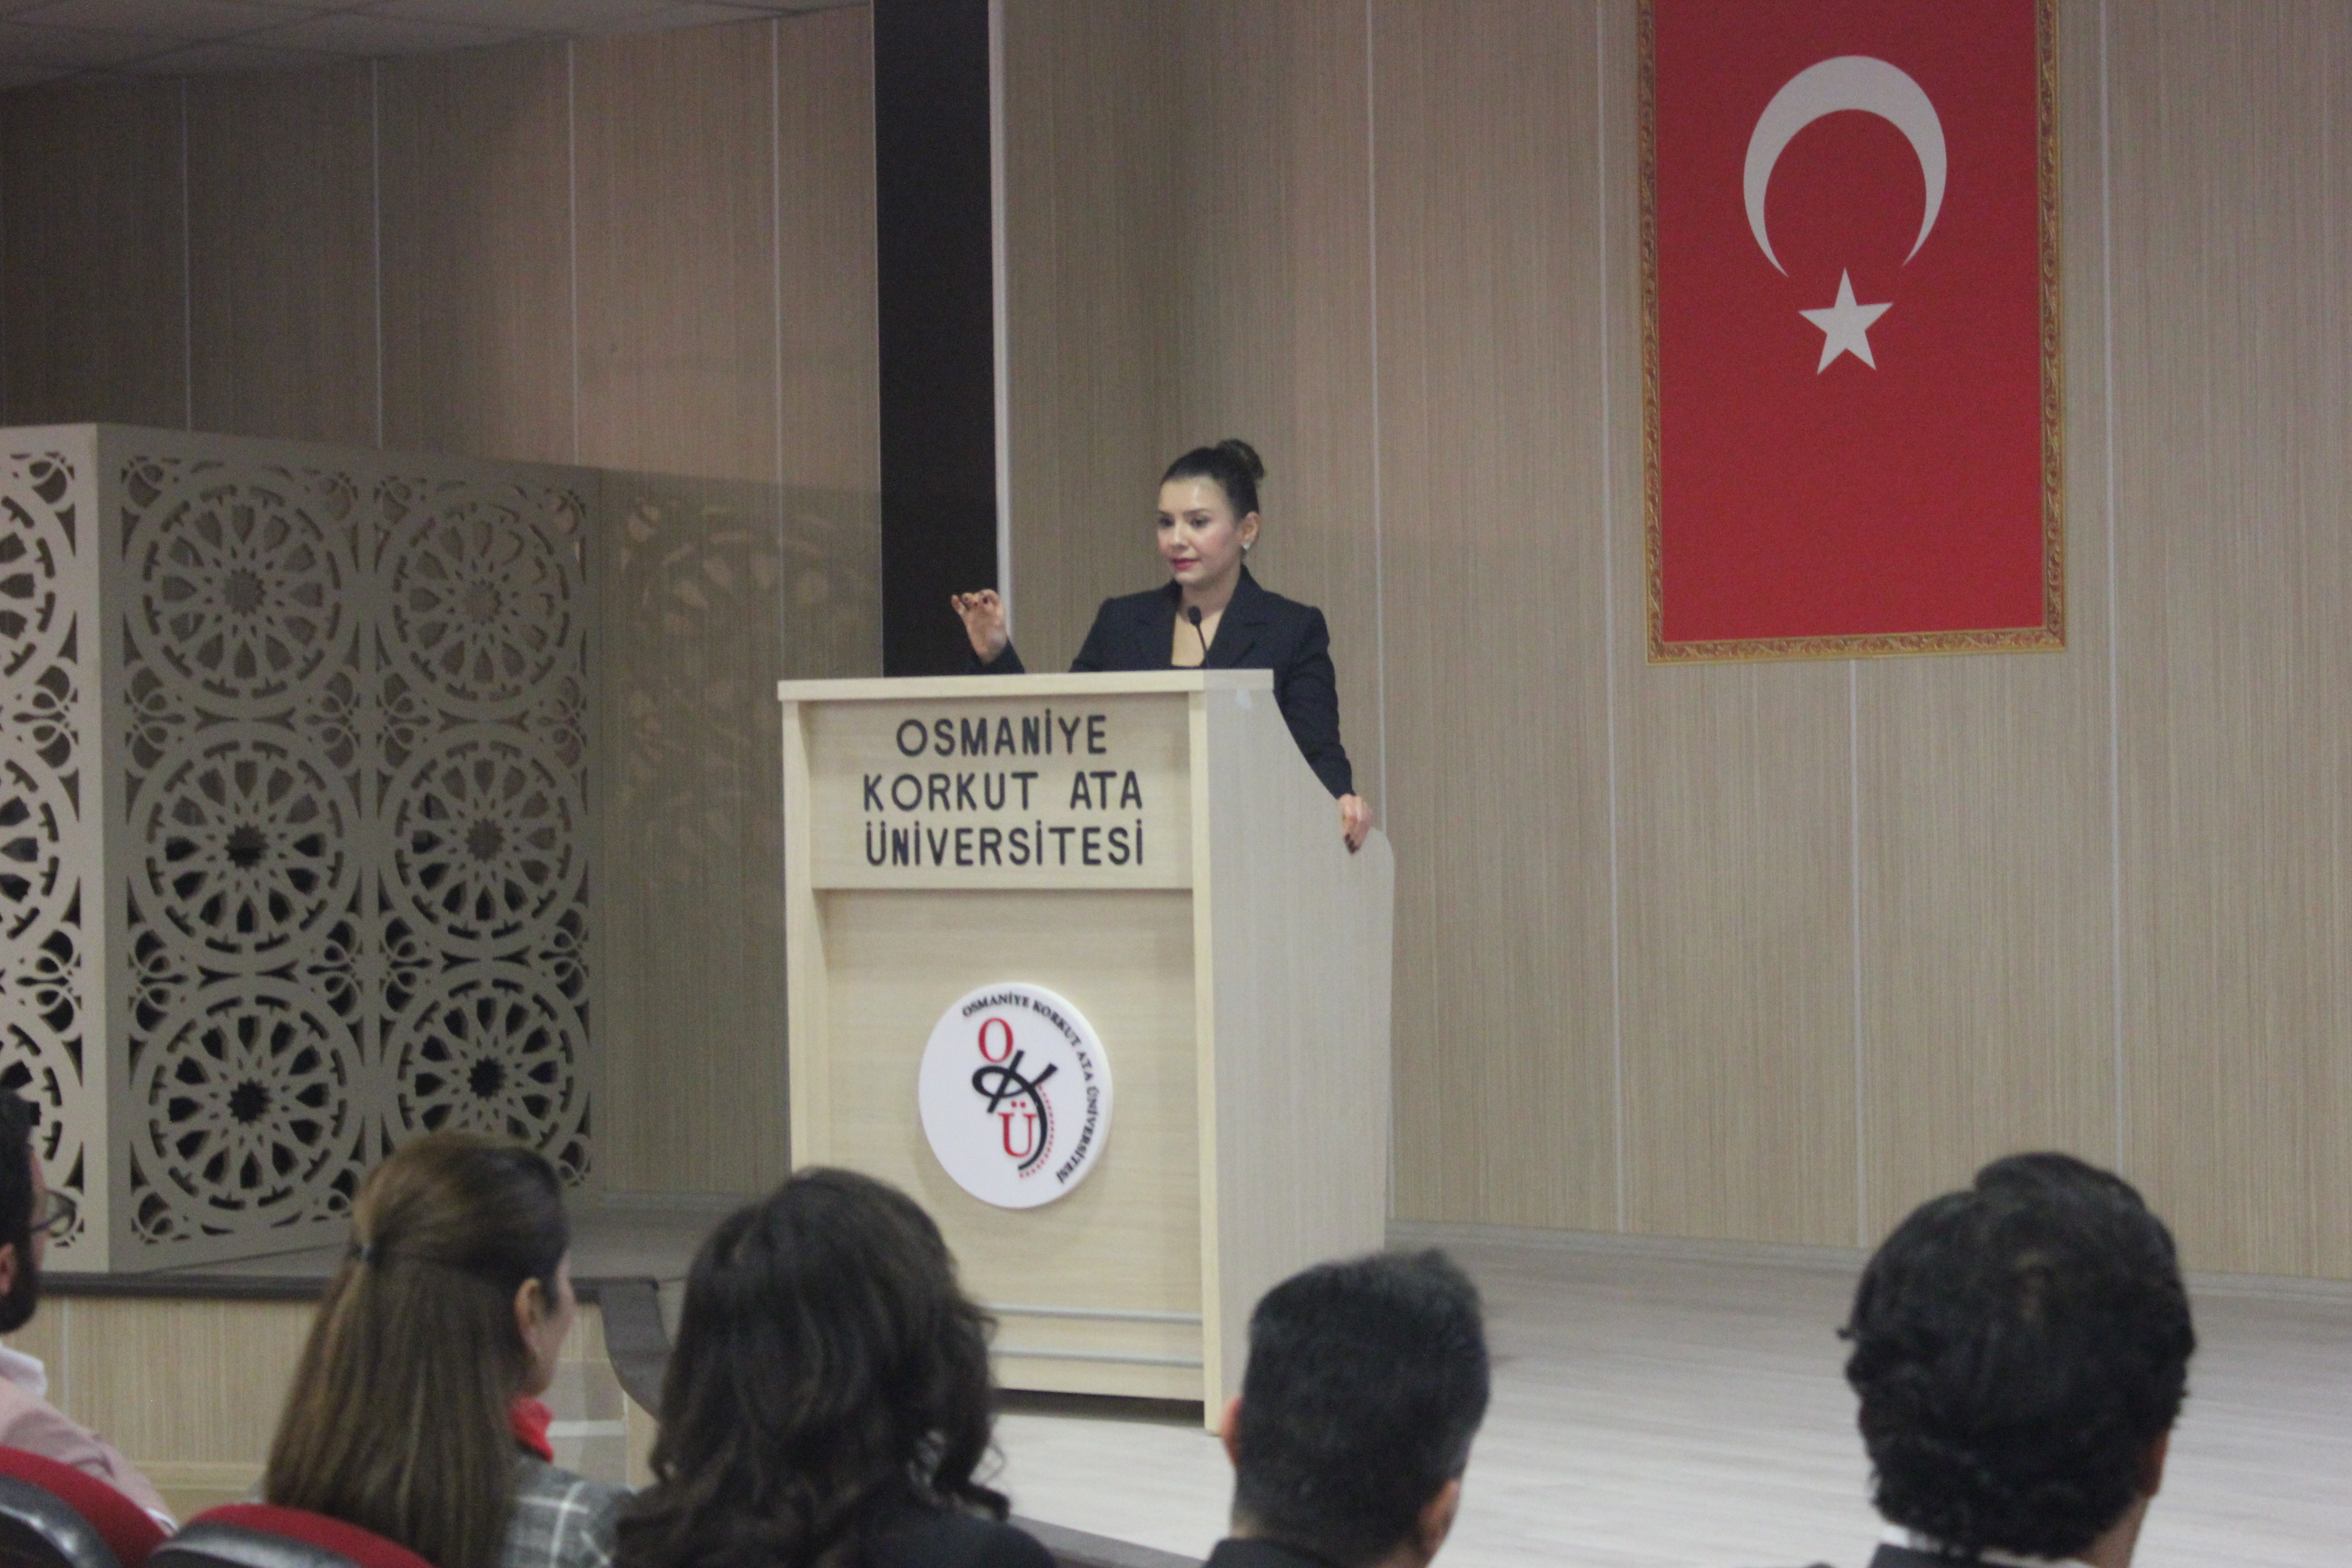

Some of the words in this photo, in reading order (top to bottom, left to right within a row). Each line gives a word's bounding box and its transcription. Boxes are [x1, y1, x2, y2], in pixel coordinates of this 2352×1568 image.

[897, 709, 1107, 757] OSMANİYE
[864, 771, 1039, 811] KORKUT
[1070, 769, 1143, 810] ATA
[866, 818, 1143, 867] ÜNİVERSİTESİ
[962, 991, 1030, 1018] OSMANİYE
[1032, 999, 1082, 1047] KORKUT
[1077, 1050, 1094, 1082] ATA
[1055, 1086, 1100, 1184] ÜNİVERSİTESİ
